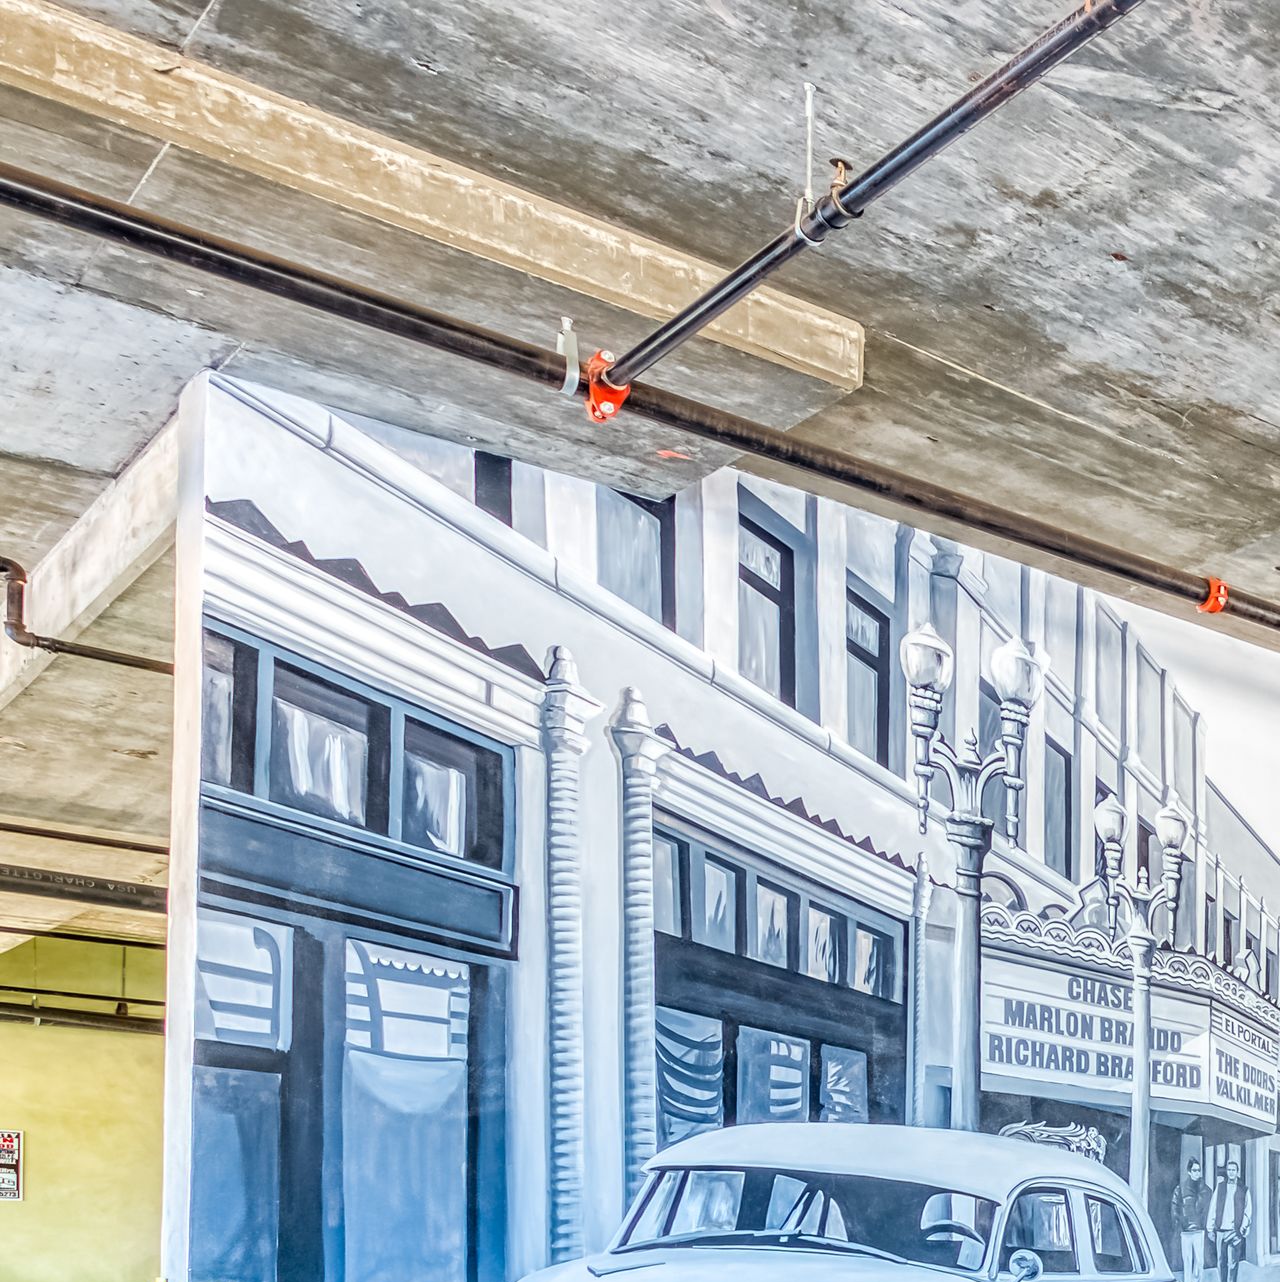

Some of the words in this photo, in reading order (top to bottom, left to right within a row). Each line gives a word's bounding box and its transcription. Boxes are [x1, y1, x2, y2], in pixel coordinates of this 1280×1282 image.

[1067, 977, 1133, 1011] CHASE
[1003, 998, 1095, 1042] MARLON
[1225, 1018, 1237, 1036] EL
[1237, 1022, 1273, 1054] PORTAL
[988, 1033, 1090, 1076] RICHARD
[1095, 1054, 1202, 1089] BRAFORD
[1216, 1049, 1241, 1079] THE
[1243, 1060, 1276, 1094] DOORS
[1216, 1076, 1235, 1101] VAL
[1235, 1083, 1276, 1116] KILMER
